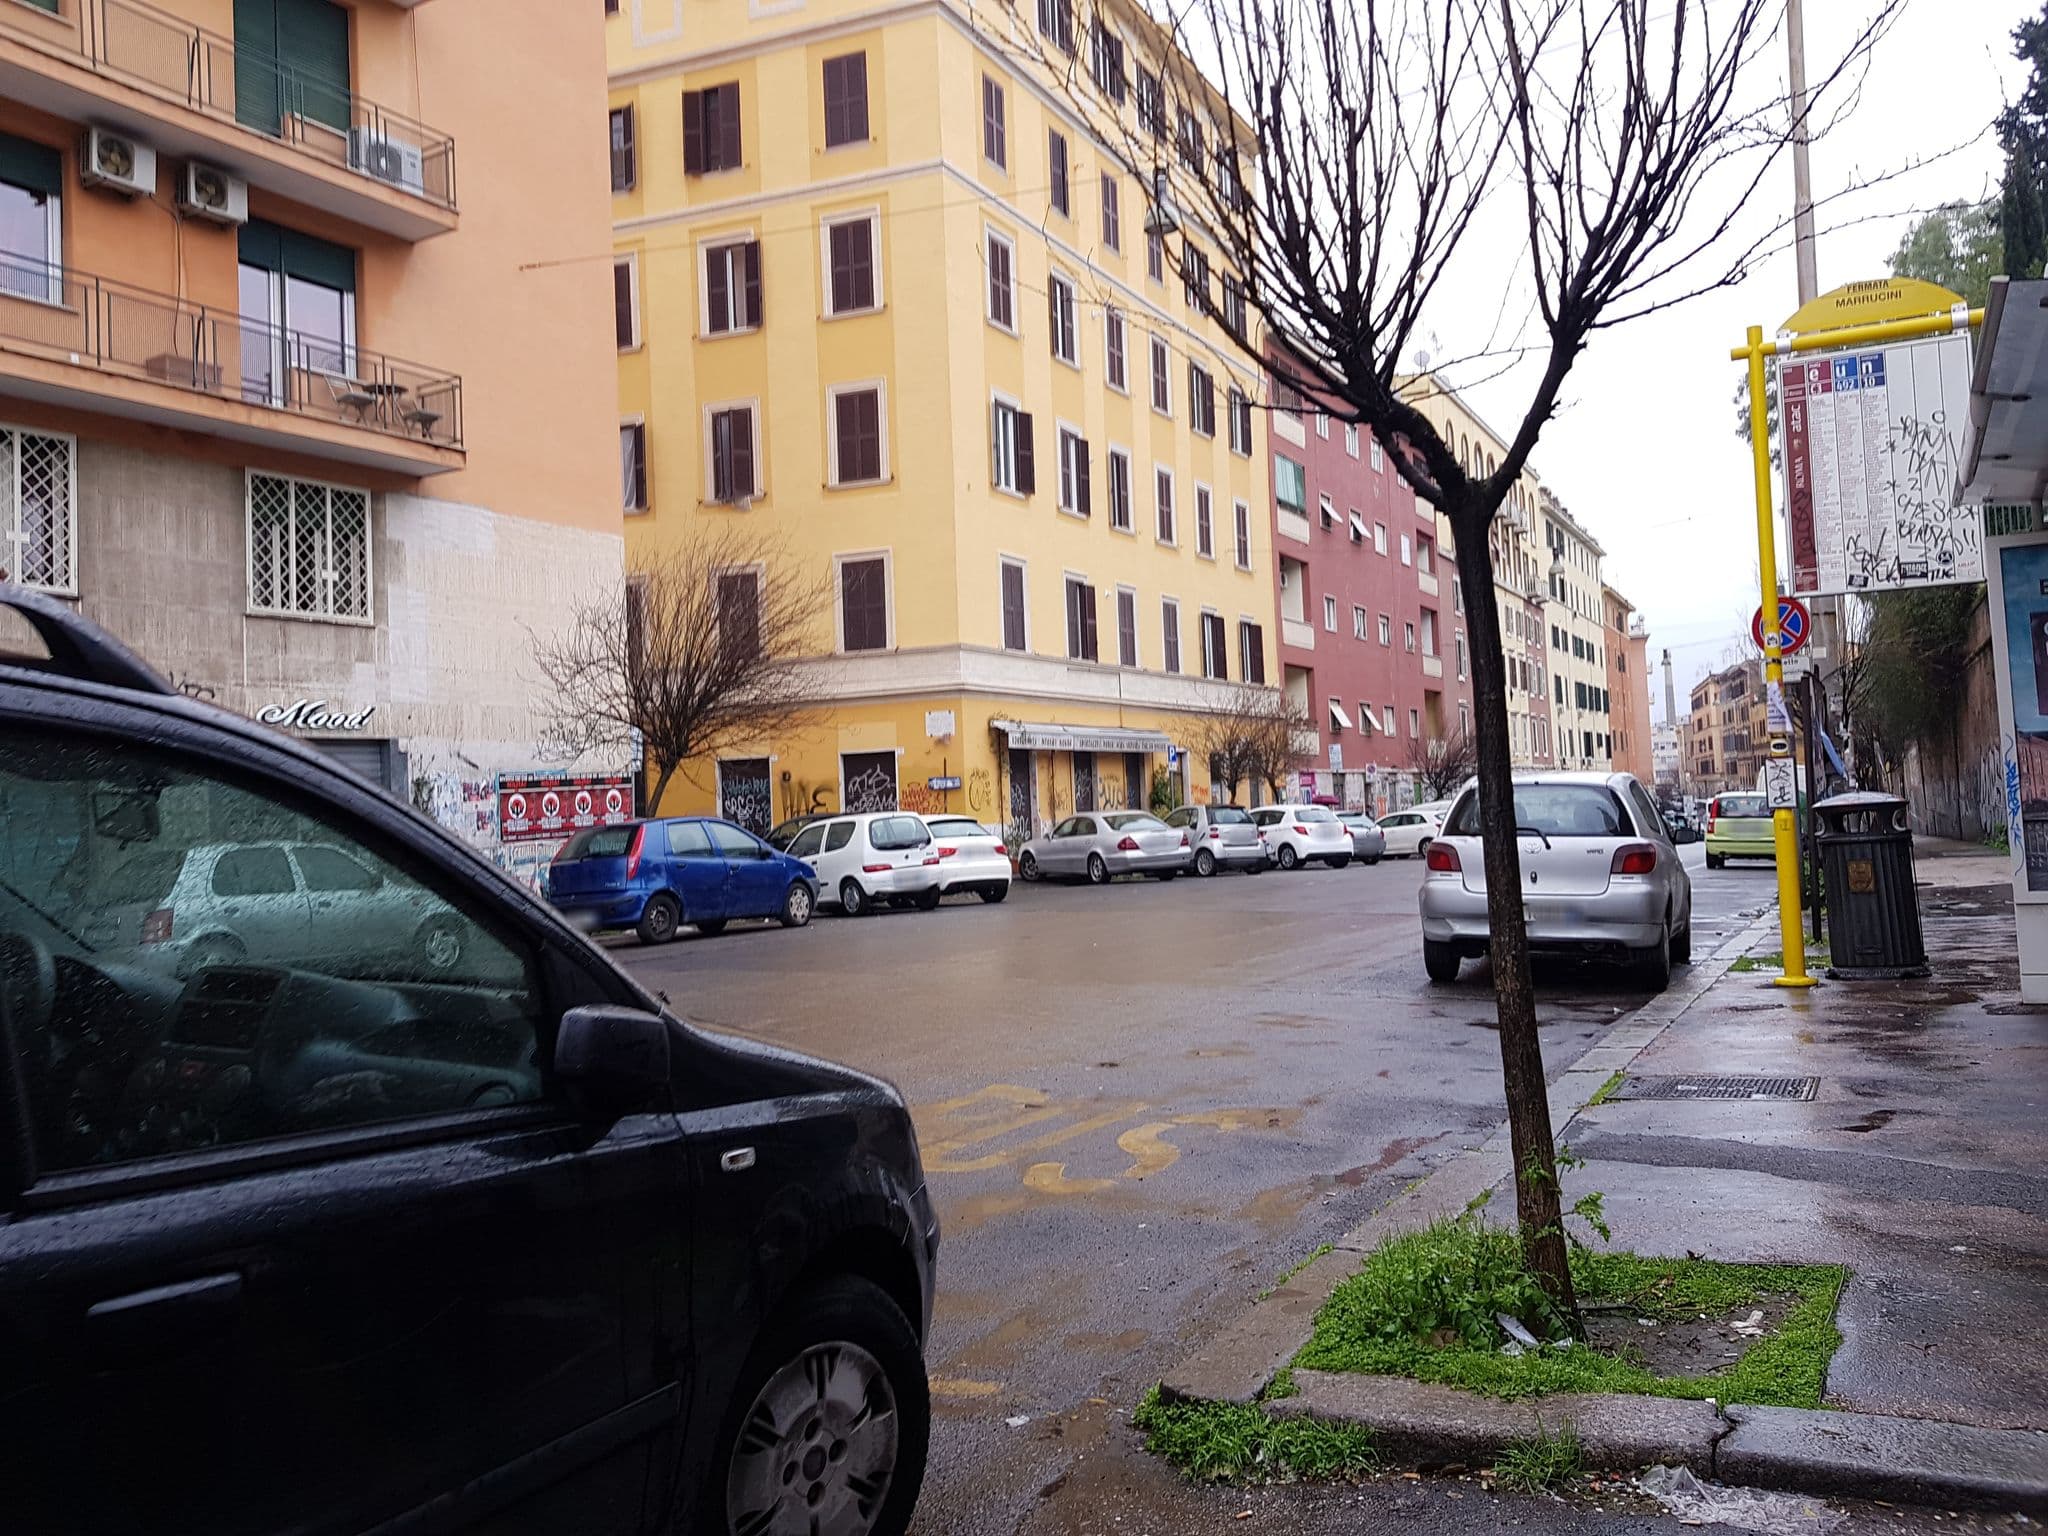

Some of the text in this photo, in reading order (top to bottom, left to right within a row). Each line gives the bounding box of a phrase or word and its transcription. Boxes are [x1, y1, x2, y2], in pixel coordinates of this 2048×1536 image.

[1847, 280, 1889, 294] FERMATA
[1835, 289, 1902, 309] MARRUCINI
[1835, 364, 1846, 377] u
[1862, 361, 1873, 375] n
[1836, 379, 1855, 392] 492
[1791, 403, 1802, 433] atac
[255, 698, 376, 730] Mood
